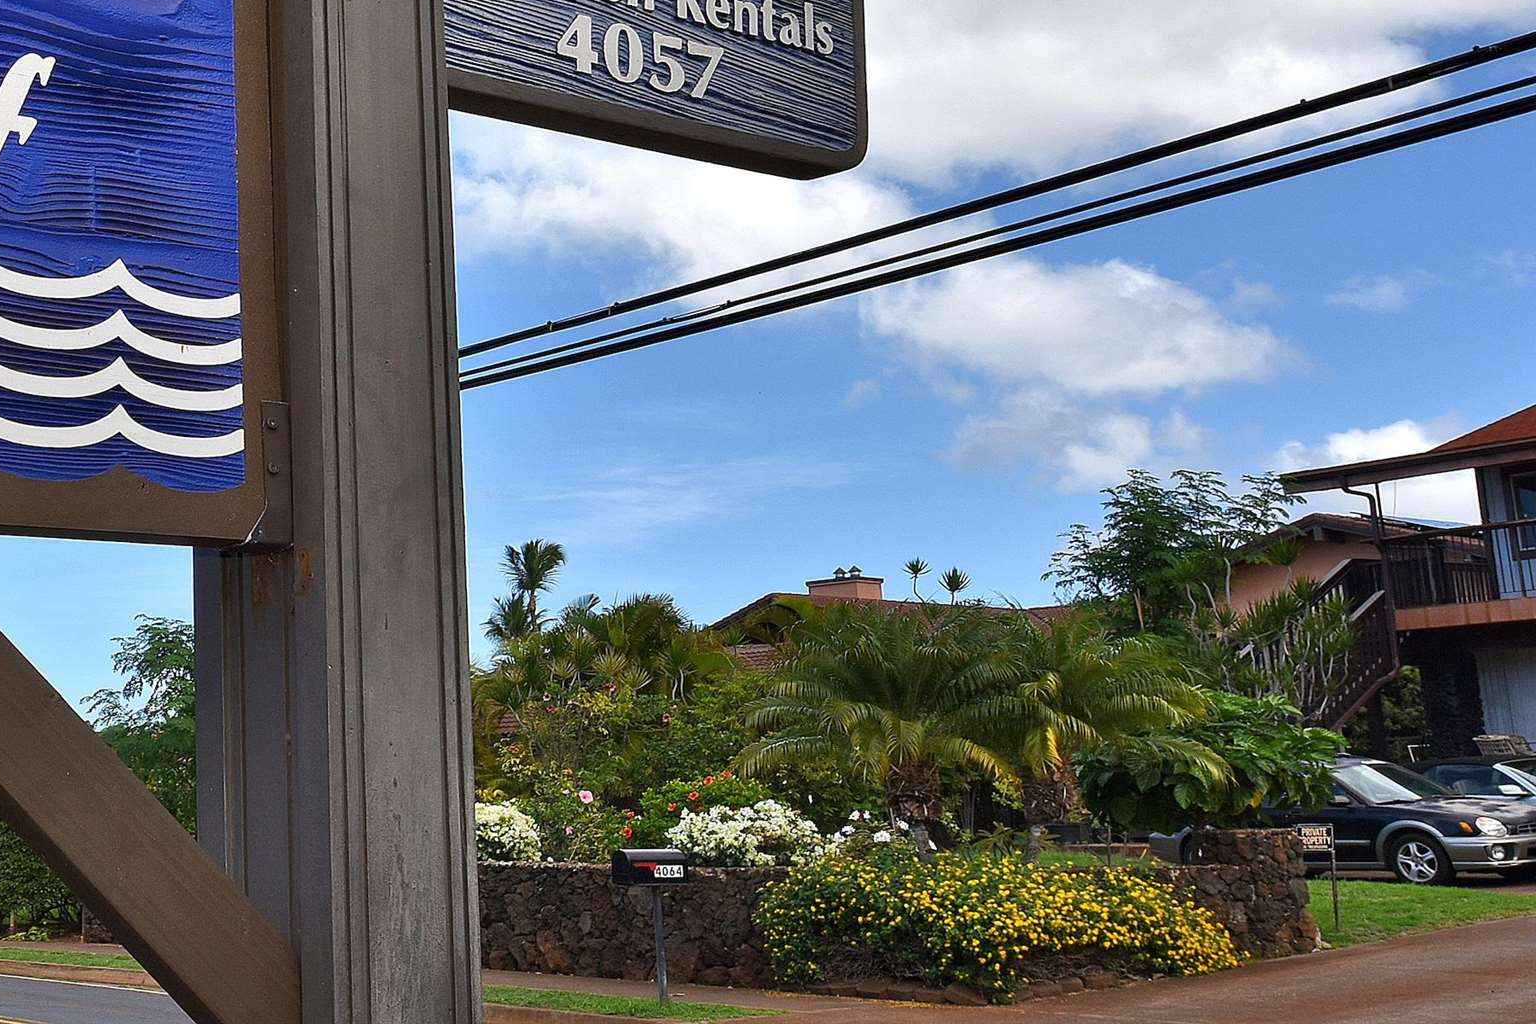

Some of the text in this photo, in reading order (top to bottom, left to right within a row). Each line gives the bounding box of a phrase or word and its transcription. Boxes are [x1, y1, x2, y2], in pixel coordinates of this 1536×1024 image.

[556, 14, 725, 99] 4057
[1301, 827, 1328, 836] PRIVATE
[1299, 836, 1332, 845] ROPERTY
[655, 866, 682, 877] 4064
